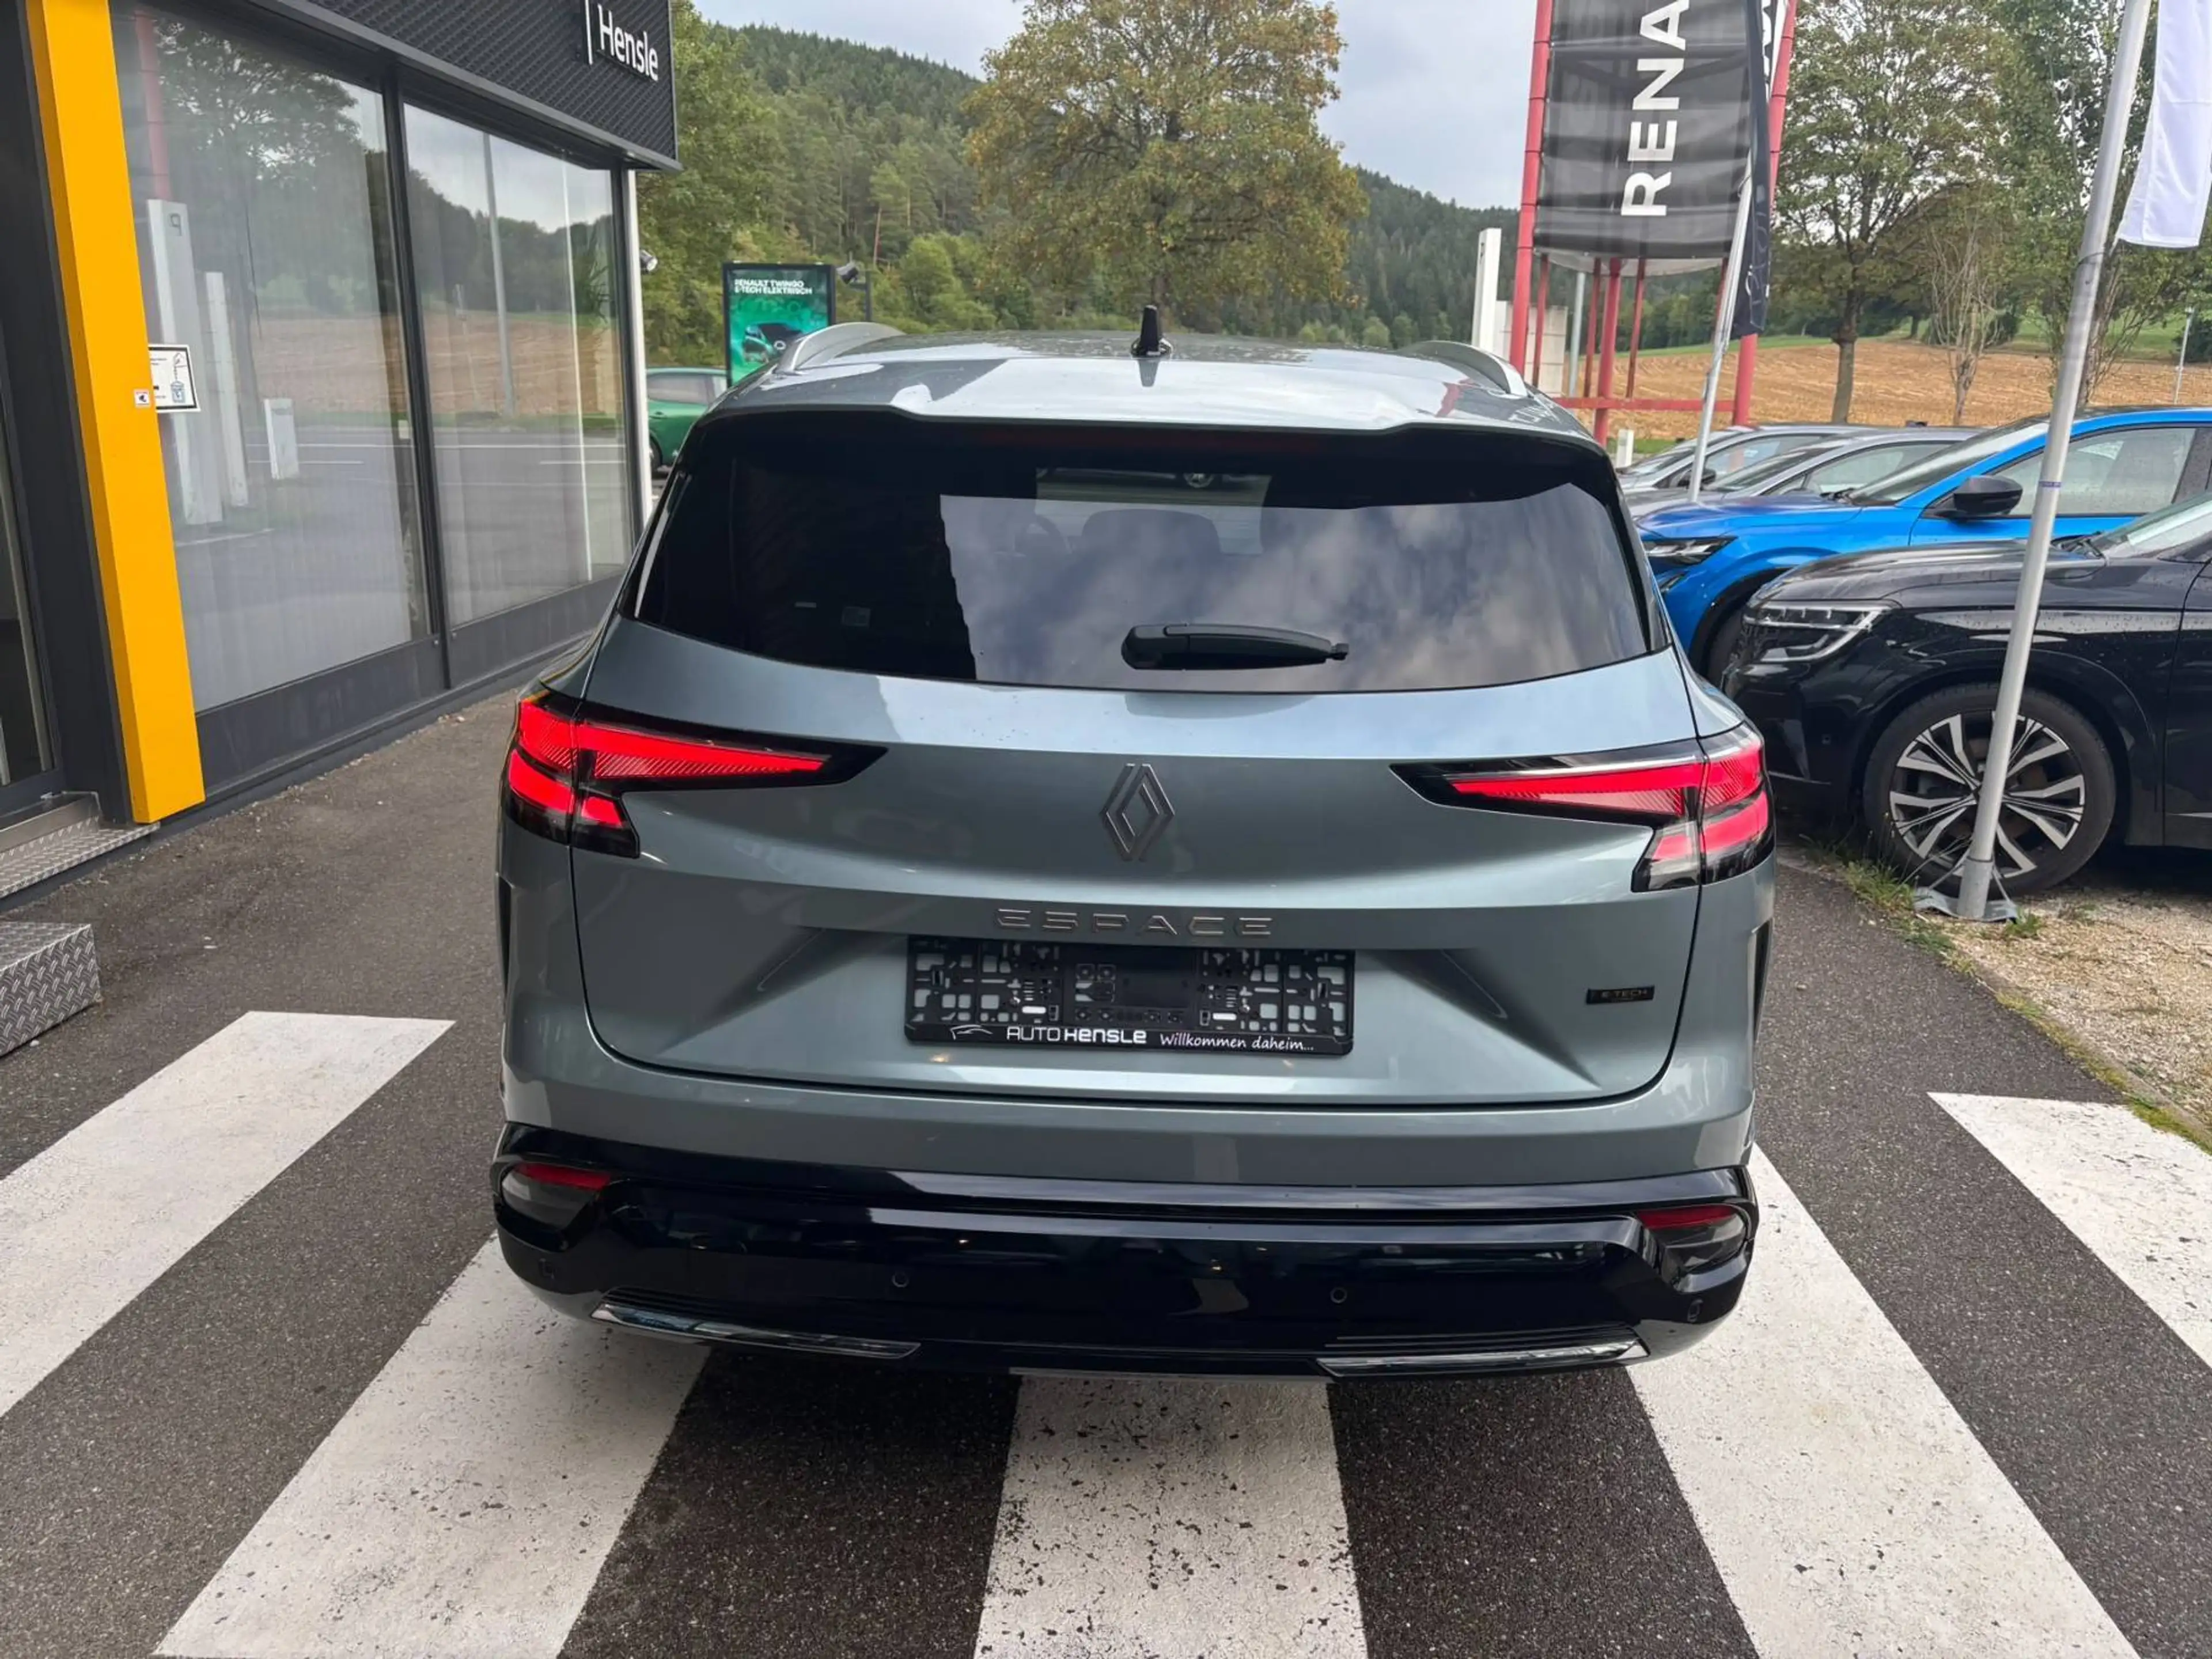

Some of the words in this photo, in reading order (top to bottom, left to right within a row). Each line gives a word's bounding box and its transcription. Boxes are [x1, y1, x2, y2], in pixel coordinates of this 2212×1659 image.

[597, 3, 658, 81] Hensle
[998, 908, 1272, 935] ESPACE
[1160, 1032, 1247, 1047] Willkommen
[1252, 1036, 1315, 1051] daheim...
